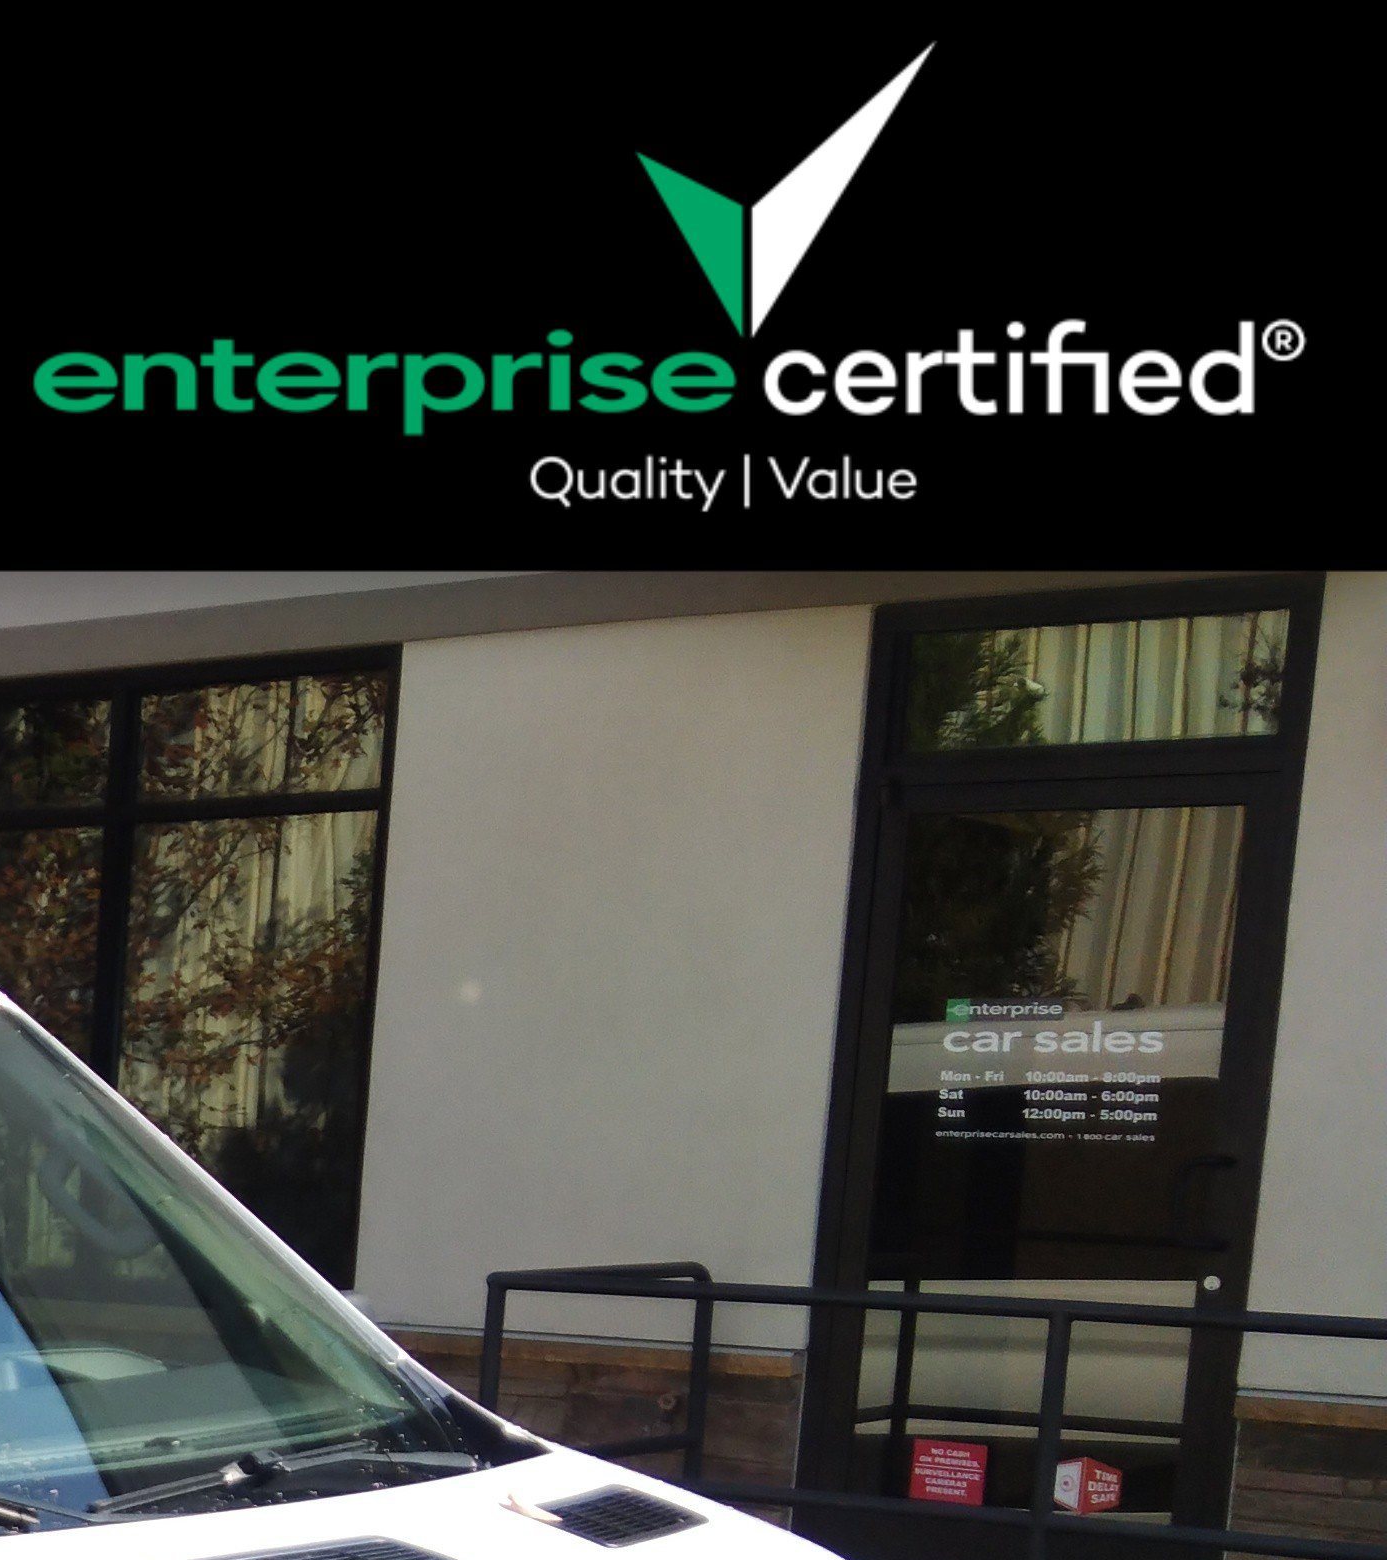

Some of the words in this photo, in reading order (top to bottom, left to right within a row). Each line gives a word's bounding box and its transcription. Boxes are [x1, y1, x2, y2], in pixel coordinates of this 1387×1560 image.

[954, 1001, 1063, 1018] enterprise
[943, 1030, 1022, 1053] car
[1033, 1020, 1164, 1053] sales
[940, 1070, 971, 1082] Mon
[985, 1070, 1005, 1082] Fri
[1026, 1071, 1089, 1083] 10:00am
[938, 1088, 964, 1100] Sat
[1024, 1089, 1088, 1101] 10:00am
[1101, 1090, 1160, 1104] 6:00pm
[937, 1106, 966, 1118] Sun
[1023, 1108, 1086, 1122] 12:00pm
[1099, 1109, 1158, 1123] 5:00pm
[931, 1448, 944, 1456] NO
[1088, 1480, 1120, 1492] DELAY
